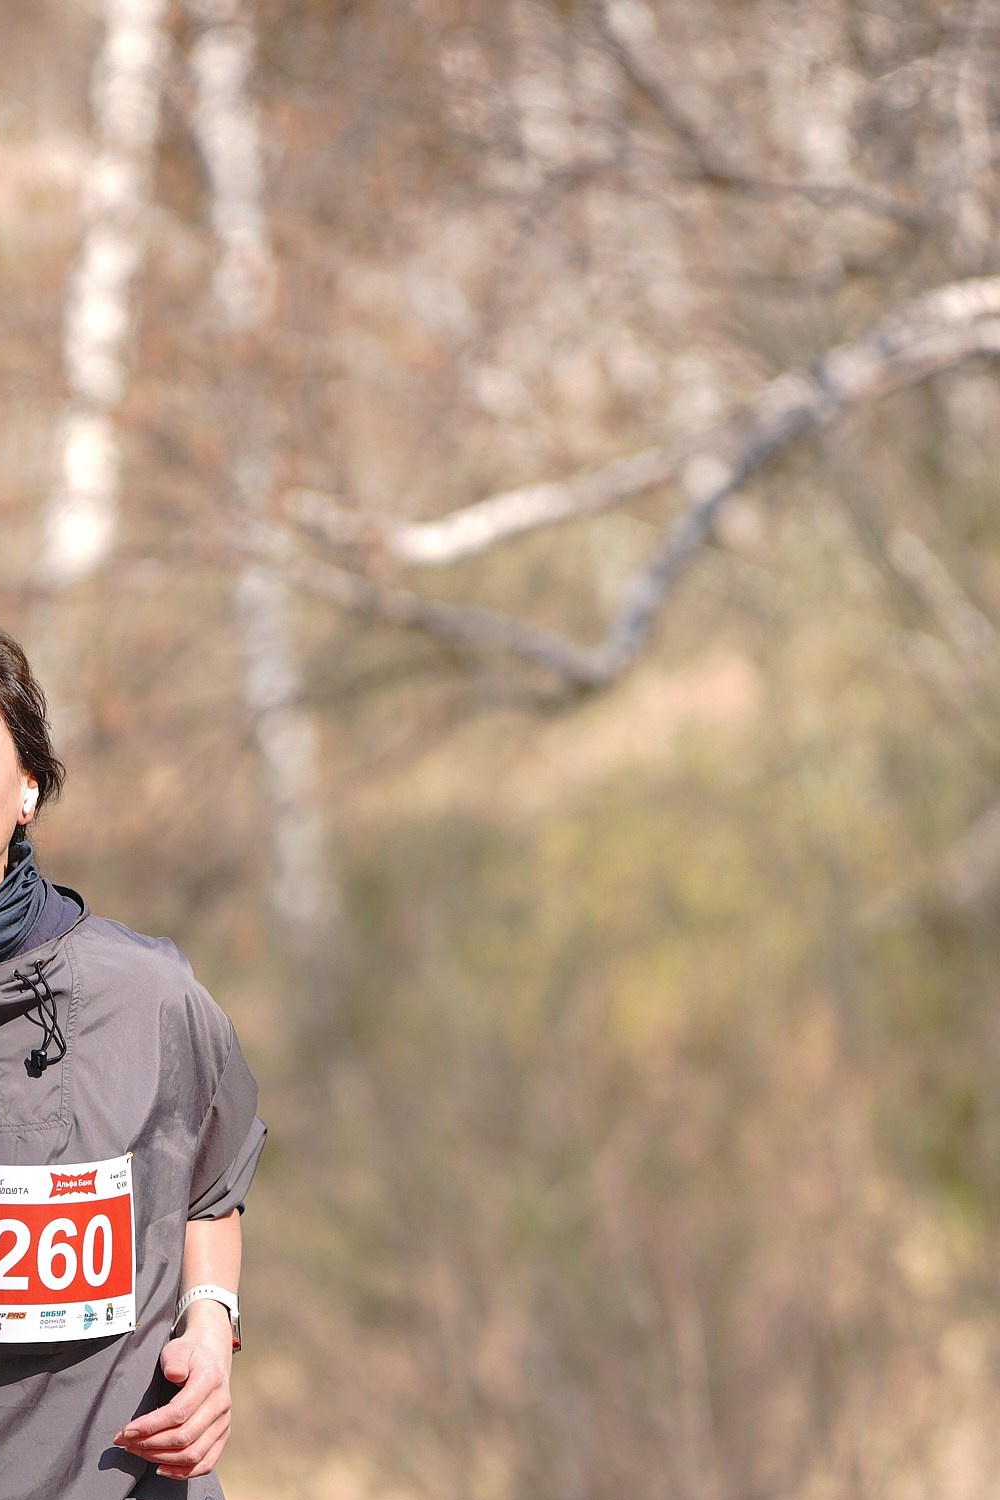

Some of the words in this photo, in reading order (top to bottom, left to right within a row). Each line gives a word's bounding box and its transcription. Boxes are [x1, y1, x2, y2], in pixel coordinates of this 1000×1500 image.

[56, 1180, 77, 1190] Альфа
[78, 1179, 93, 1187] Банк
[8, 1312, 27, 1320] PRO
[40, 1309, 67, 1318] СИБУР
